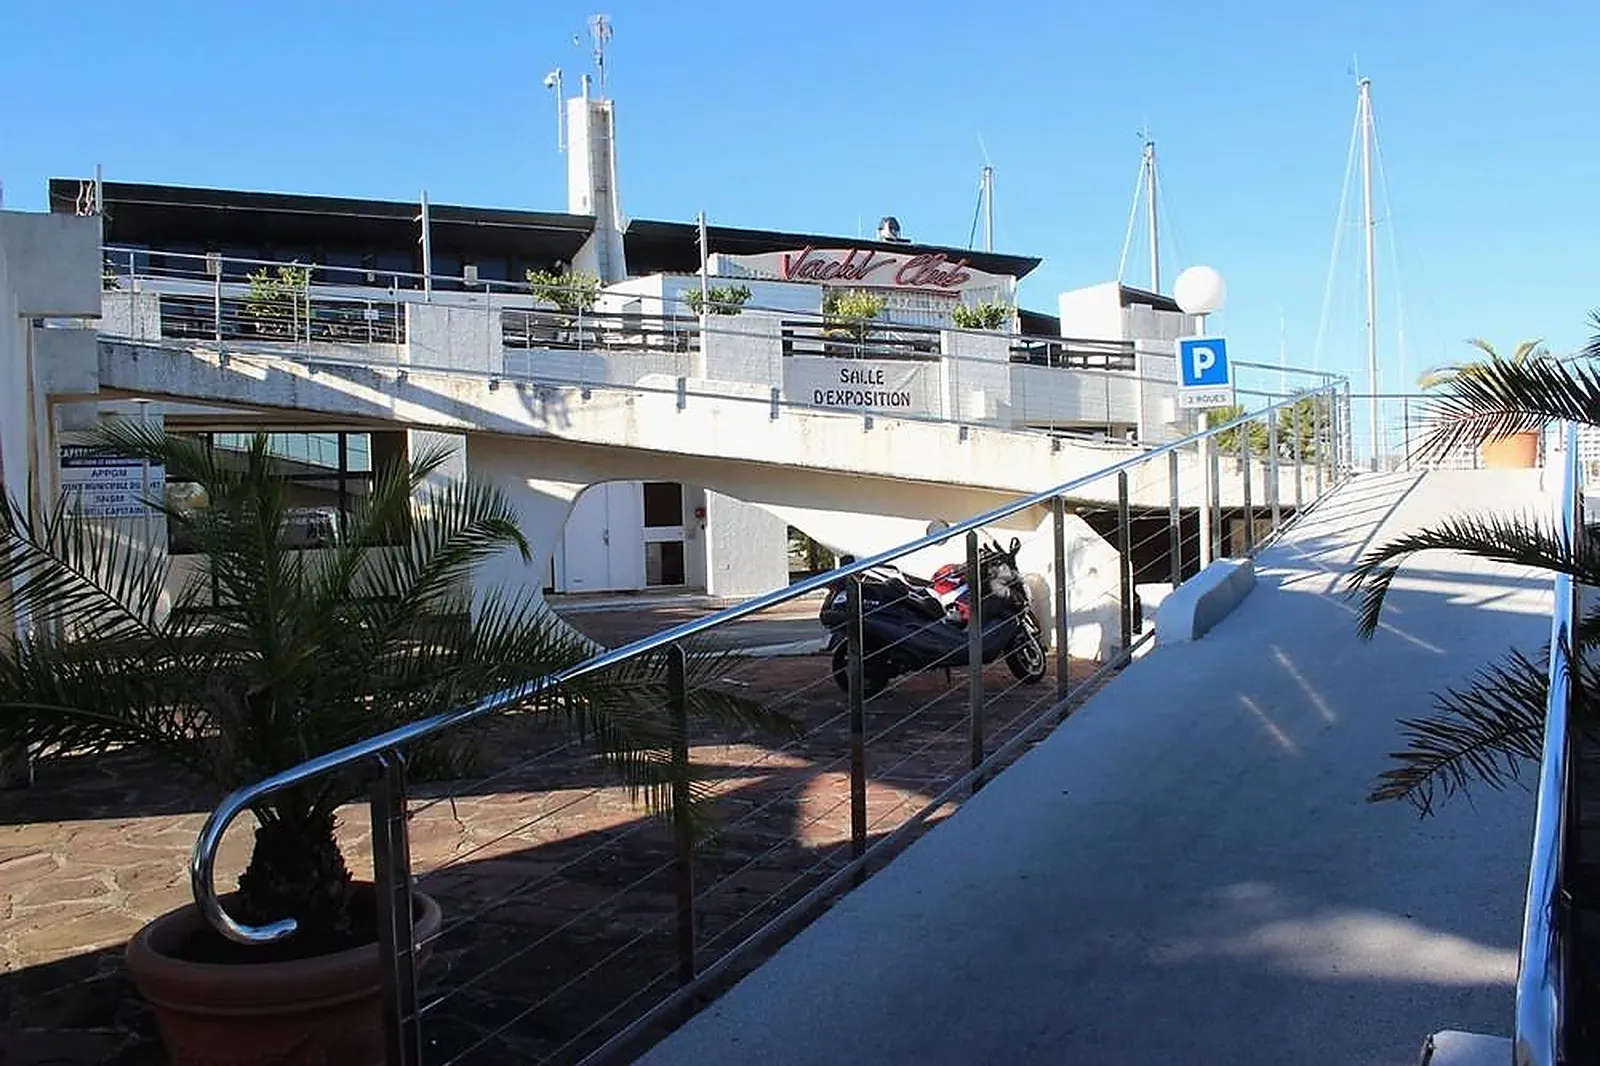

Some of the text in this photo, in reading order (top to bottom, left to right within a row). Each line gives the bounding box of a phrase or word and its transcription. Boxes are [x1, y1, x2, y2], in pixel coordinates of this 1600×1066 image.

[896, 253, 971, 287] Club
[1193, 347, 1216, 379] P
[840, 368, 884, 385] SALLE
[814, 389, 910, 406] D'EXPOSITION
